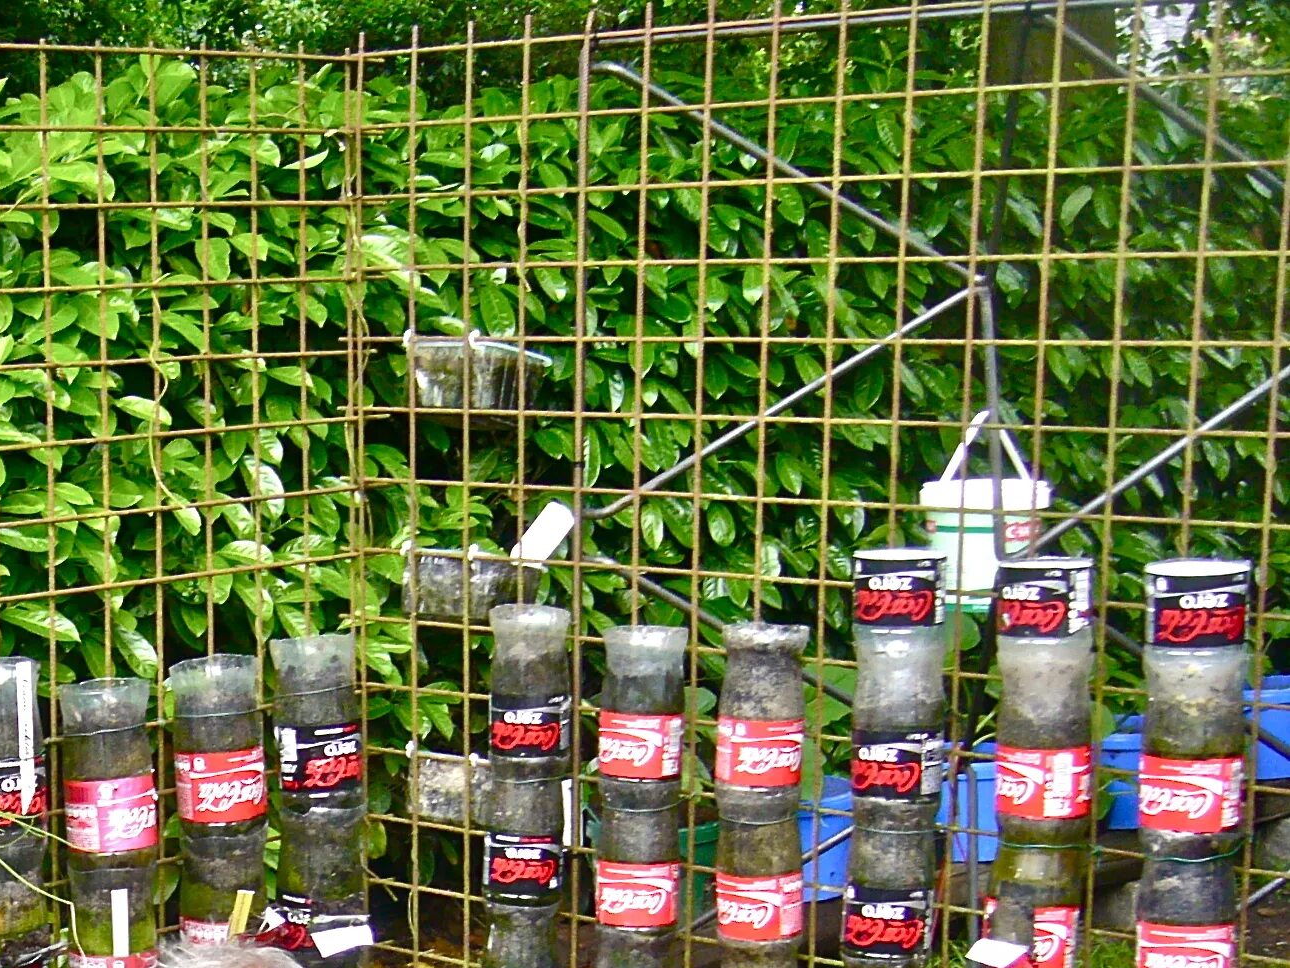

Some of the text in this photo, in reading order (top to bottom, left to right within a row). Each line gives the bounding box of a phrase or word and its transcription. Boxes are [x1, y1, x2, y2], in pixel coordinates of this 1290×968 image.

[868, 577, 912, 591] zero
[1003, 586, 1040, 601] zero
[855, 590, 933, 621] Coca-Cola
[1180, 593, 1229, 609] zero
[1158, 606, 1244, 642] Coca-Cola
[504, 711, 542, 724] zero
[492, 722, 560, 750] Coca-Cola
[324, 742, 358, 757] zero
[737, 745, 802, 774] Coca-Cola
[858, 746, 898, 763] zero
[1141, 783, 1213, 817] Coca-Cola
[505, 847, 541, 860] zero
[491, 858, 553, 883] Coca-Cola
[599, 888, 666, 914] Coca-Cola
[862, 904, 904, 920] zero
[847, 914, 924, 948] Coca-Cola
